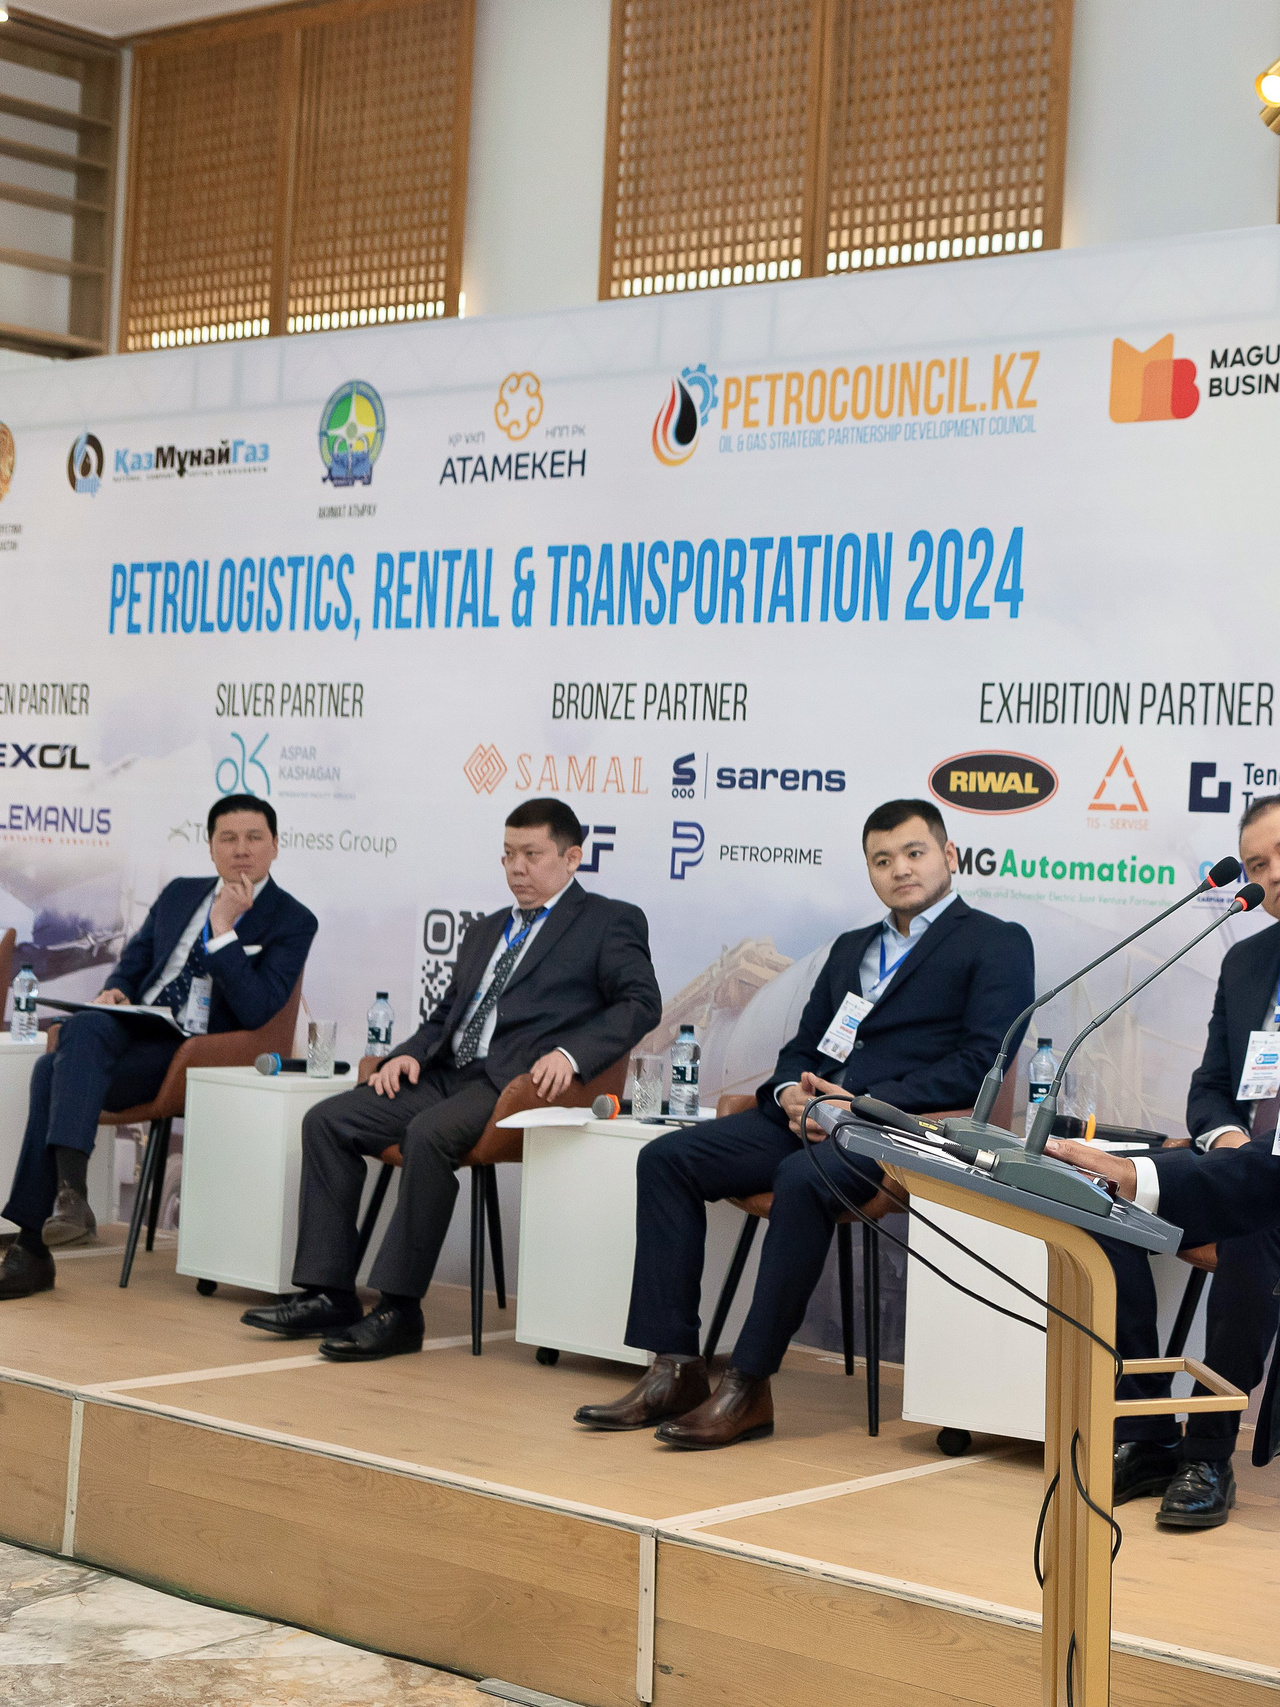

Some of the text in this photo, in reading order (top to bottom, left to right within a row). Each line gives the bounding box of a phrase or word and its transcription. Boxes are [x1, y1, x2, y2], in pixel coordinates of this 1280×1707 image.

[721, 350, 1041, 430] PETROCOUNCIL.KZ
[718, 434, 734, 453] OIL
[746, 432, 767, 452] GAS
[769, 427, 826, 450] STRATEGIC
[828, 423, 902, 446] PARTNERSHIP
[903, 417, 986, 441] DEVELOPMENT
[988, 413, 1037, 436] COUNCIL
[107, 526, 1025, 641] PETROLOGISTICS, RENTAL & TRANSPORTATION 2024
[18, 683, 90, 717] PARTNER
[215, 682, 364, 719] SILVER PARTNER
[551, 682, 749, 722] BRONZE PARTNER
[979, 682, 1275, 727] EXHIBITION PARTNER
[278, 765, 341, 782] KASHAGAN
[514, 752, 650, 795] SAMAL
[715, 764, 847, 793] sarens
[948, 769, 1040, 795] RIWAL
[279, 825, 398, 858] siness Group
[719, 844, 823, 866] PETROPRIME
[952, 846, 1175, 886] MGAutomation
